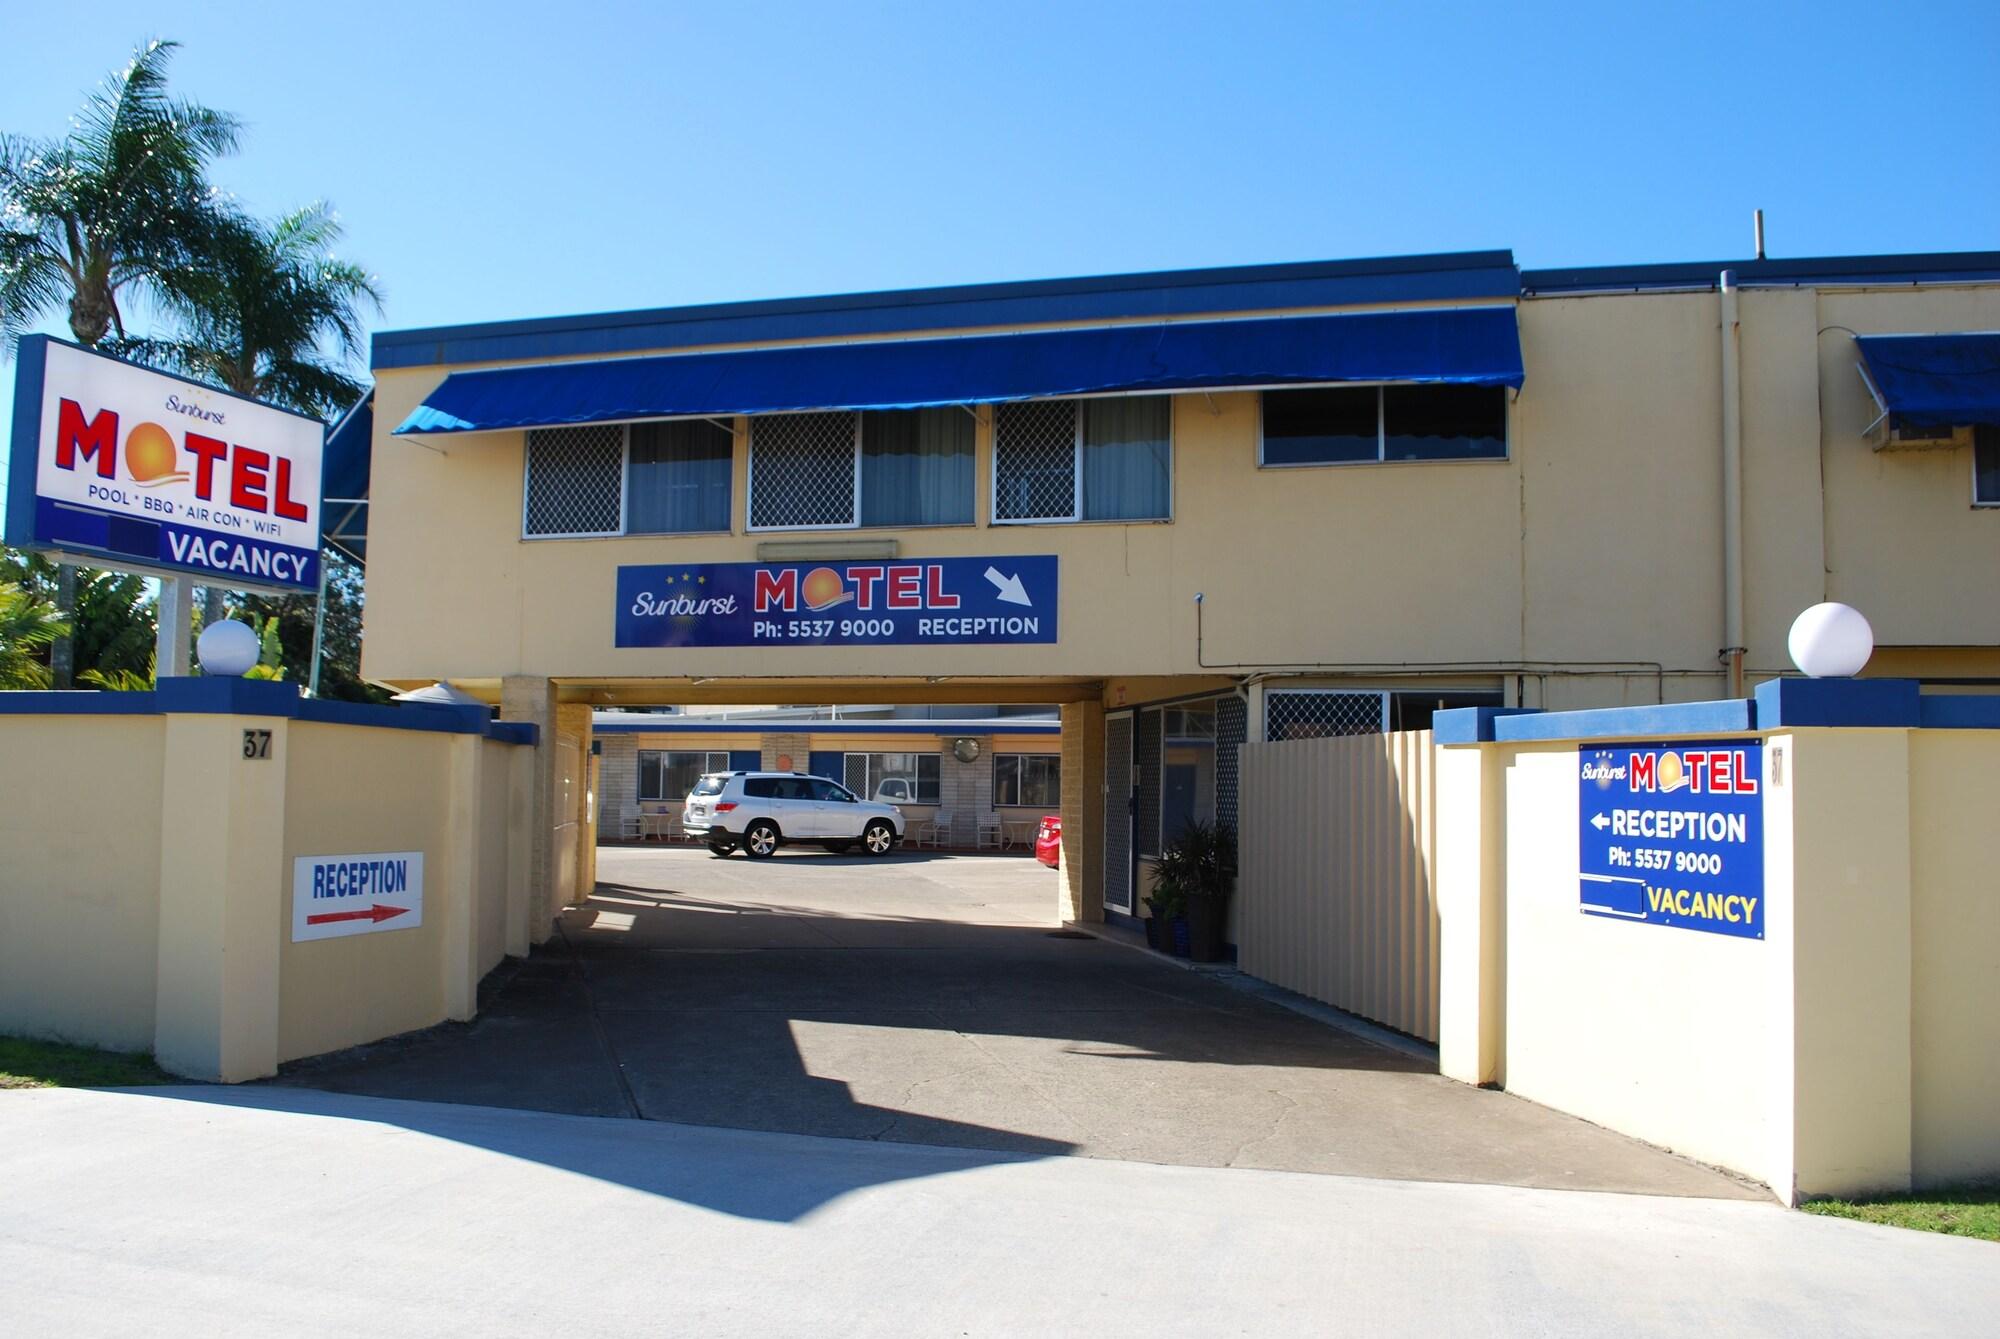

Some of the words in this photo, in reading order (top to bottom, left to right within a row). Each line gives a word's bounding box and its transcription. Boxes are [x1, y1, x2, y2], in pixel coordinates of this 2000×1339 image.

[165, 394, 226, 425] Sunburst
[88, 484, 130, 506] POOL
[143, 496, 174, 515] BBQ
[186, 506, 209, 522] AIR
[213, 511, 241, 528] CON
[253, 519, 281, 537] WIFI
[167, 530, 309, 582] VACANCY
[631, 591, 739, 617] Sunburst
[753, 621, 783, 639] Ph:
[788, 620, 835, 638] 5537
[840, 619, 895, 637] 9000
[918, 616, 1039, 636] RECEPTION
[244, 731, 272, 758] 37
[1581, 762, 1627, 781] Sunburst
[1612, 808, 1746, 844] RECEPTION
[1608, 846, 1632, 867] Ph:
[1634, 848, 1672, 870] 5537
[1675, 852, 1722, 876] 9000
[313, 859, 407, 899] RECEPTION
[1647, 885, 1758, 925] VACANCY
